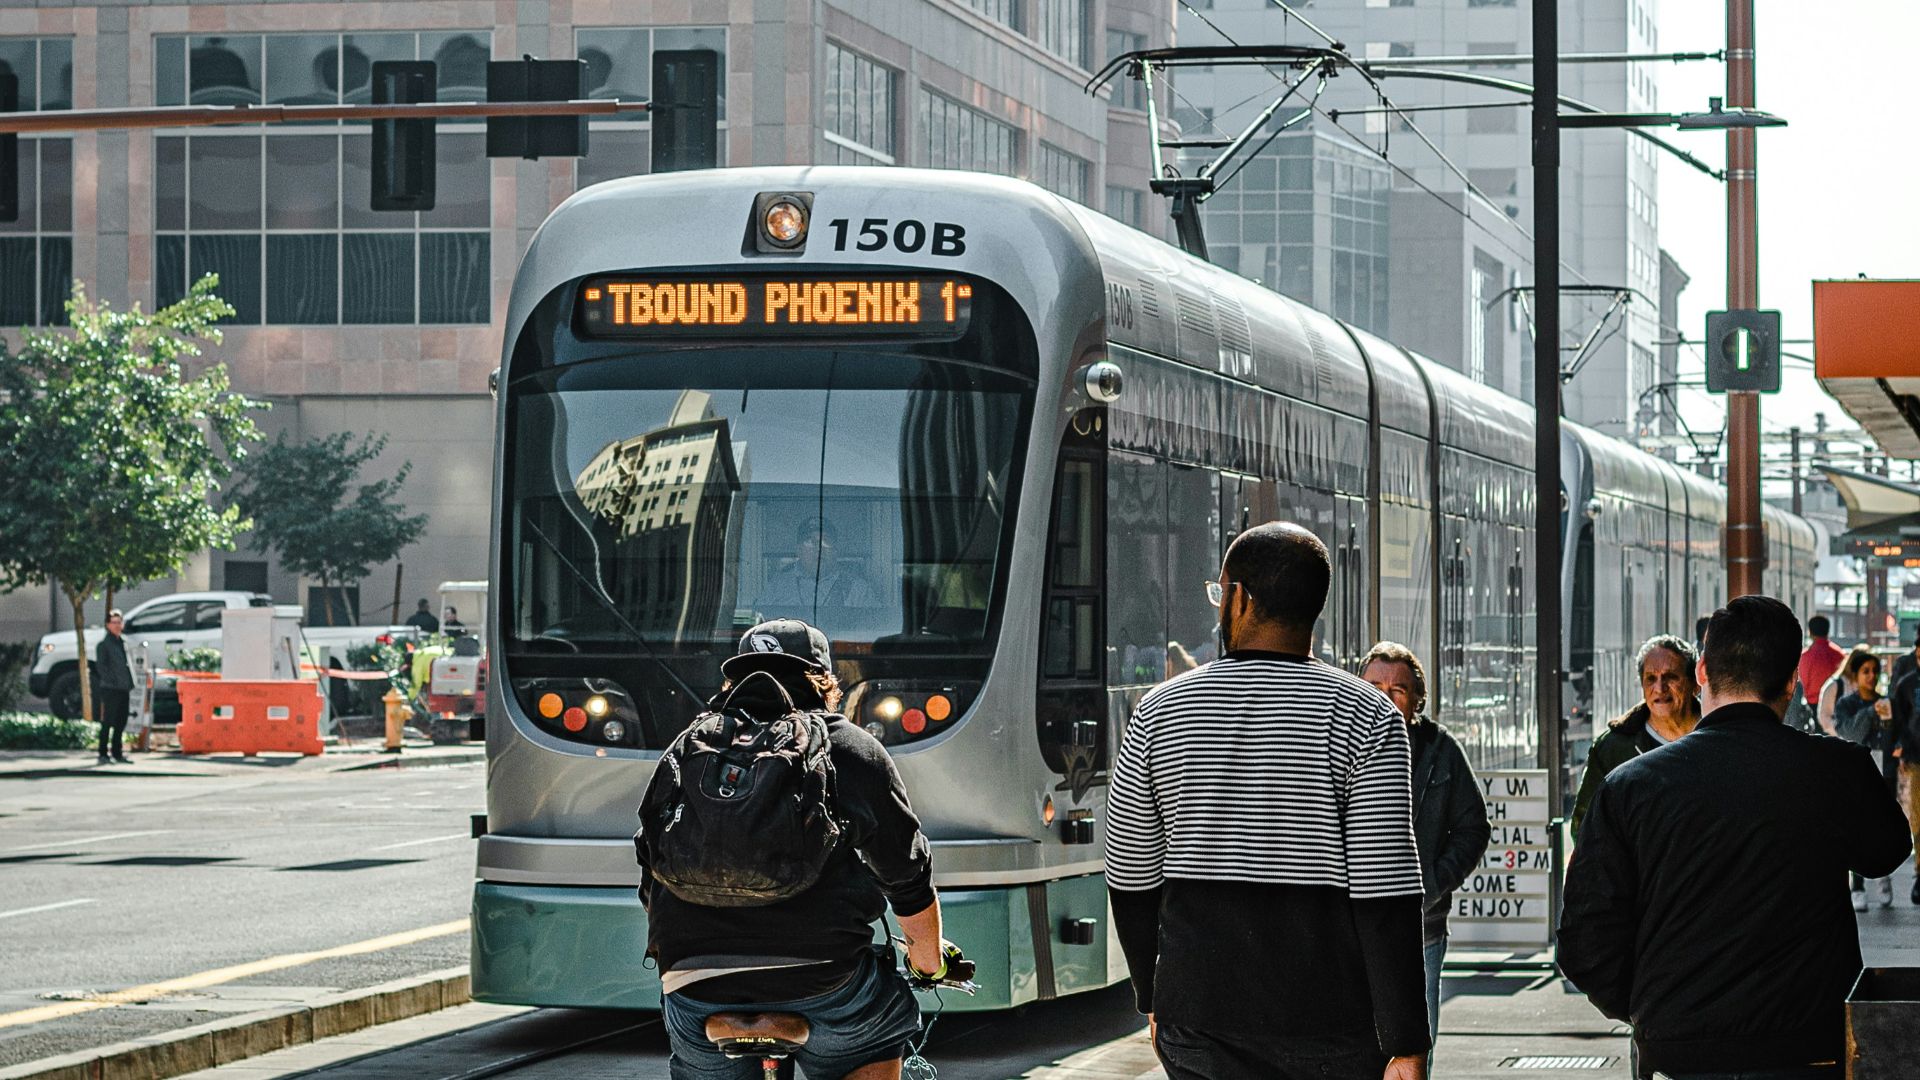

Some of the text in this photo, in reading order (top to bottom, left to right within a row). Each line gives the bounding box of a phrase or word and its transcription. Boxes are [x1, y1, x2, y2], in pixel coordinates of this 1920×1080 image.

[828, 218, 966, 257] 150B
[608, 283, 746, 324] TBOUND
[765, 282, 919, 323] PHOENIX
[1108, 283, 1133, 330] 150B
[1459, 899, 1524, 917] ENJOY
